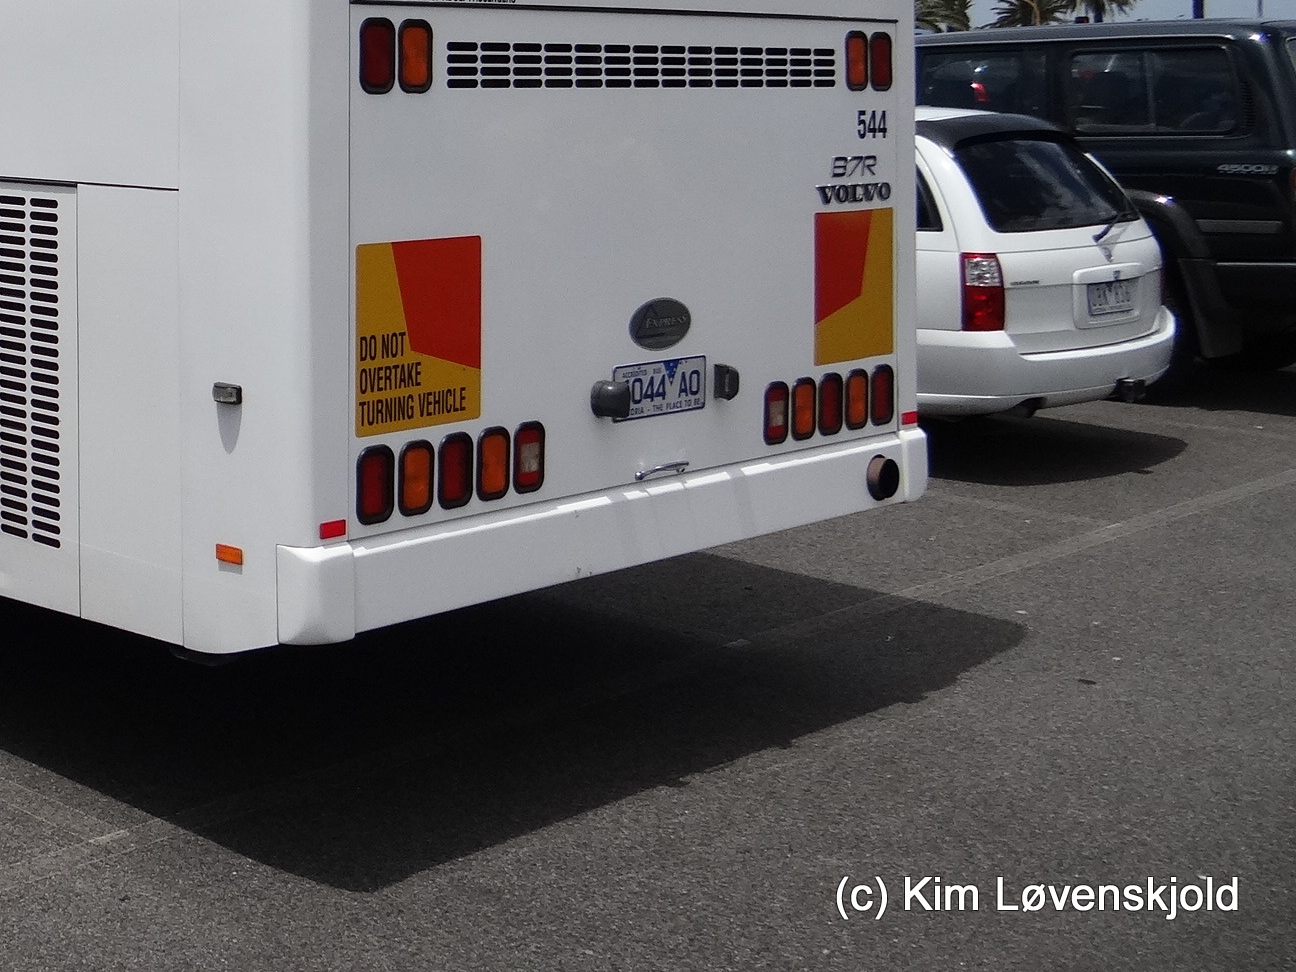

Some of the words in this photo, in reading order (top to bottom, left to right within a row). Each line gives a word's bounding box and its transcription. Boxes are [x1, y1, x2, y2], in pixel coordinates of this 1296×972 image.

[857, 110, 888, 139] 544
[831, 155, 877, 177] B7R
[815, 182, 891, 205] VOLVO
[360, 334, 377, 361] DO
[381, 332, 406, 359] NOT
[360, 362, 422, 394] OVERTAKE
[625, 374, 666, 405] 044
[359, 394, 414, 426] TURNING
[418, 387, 466, 417] VEHICLE
